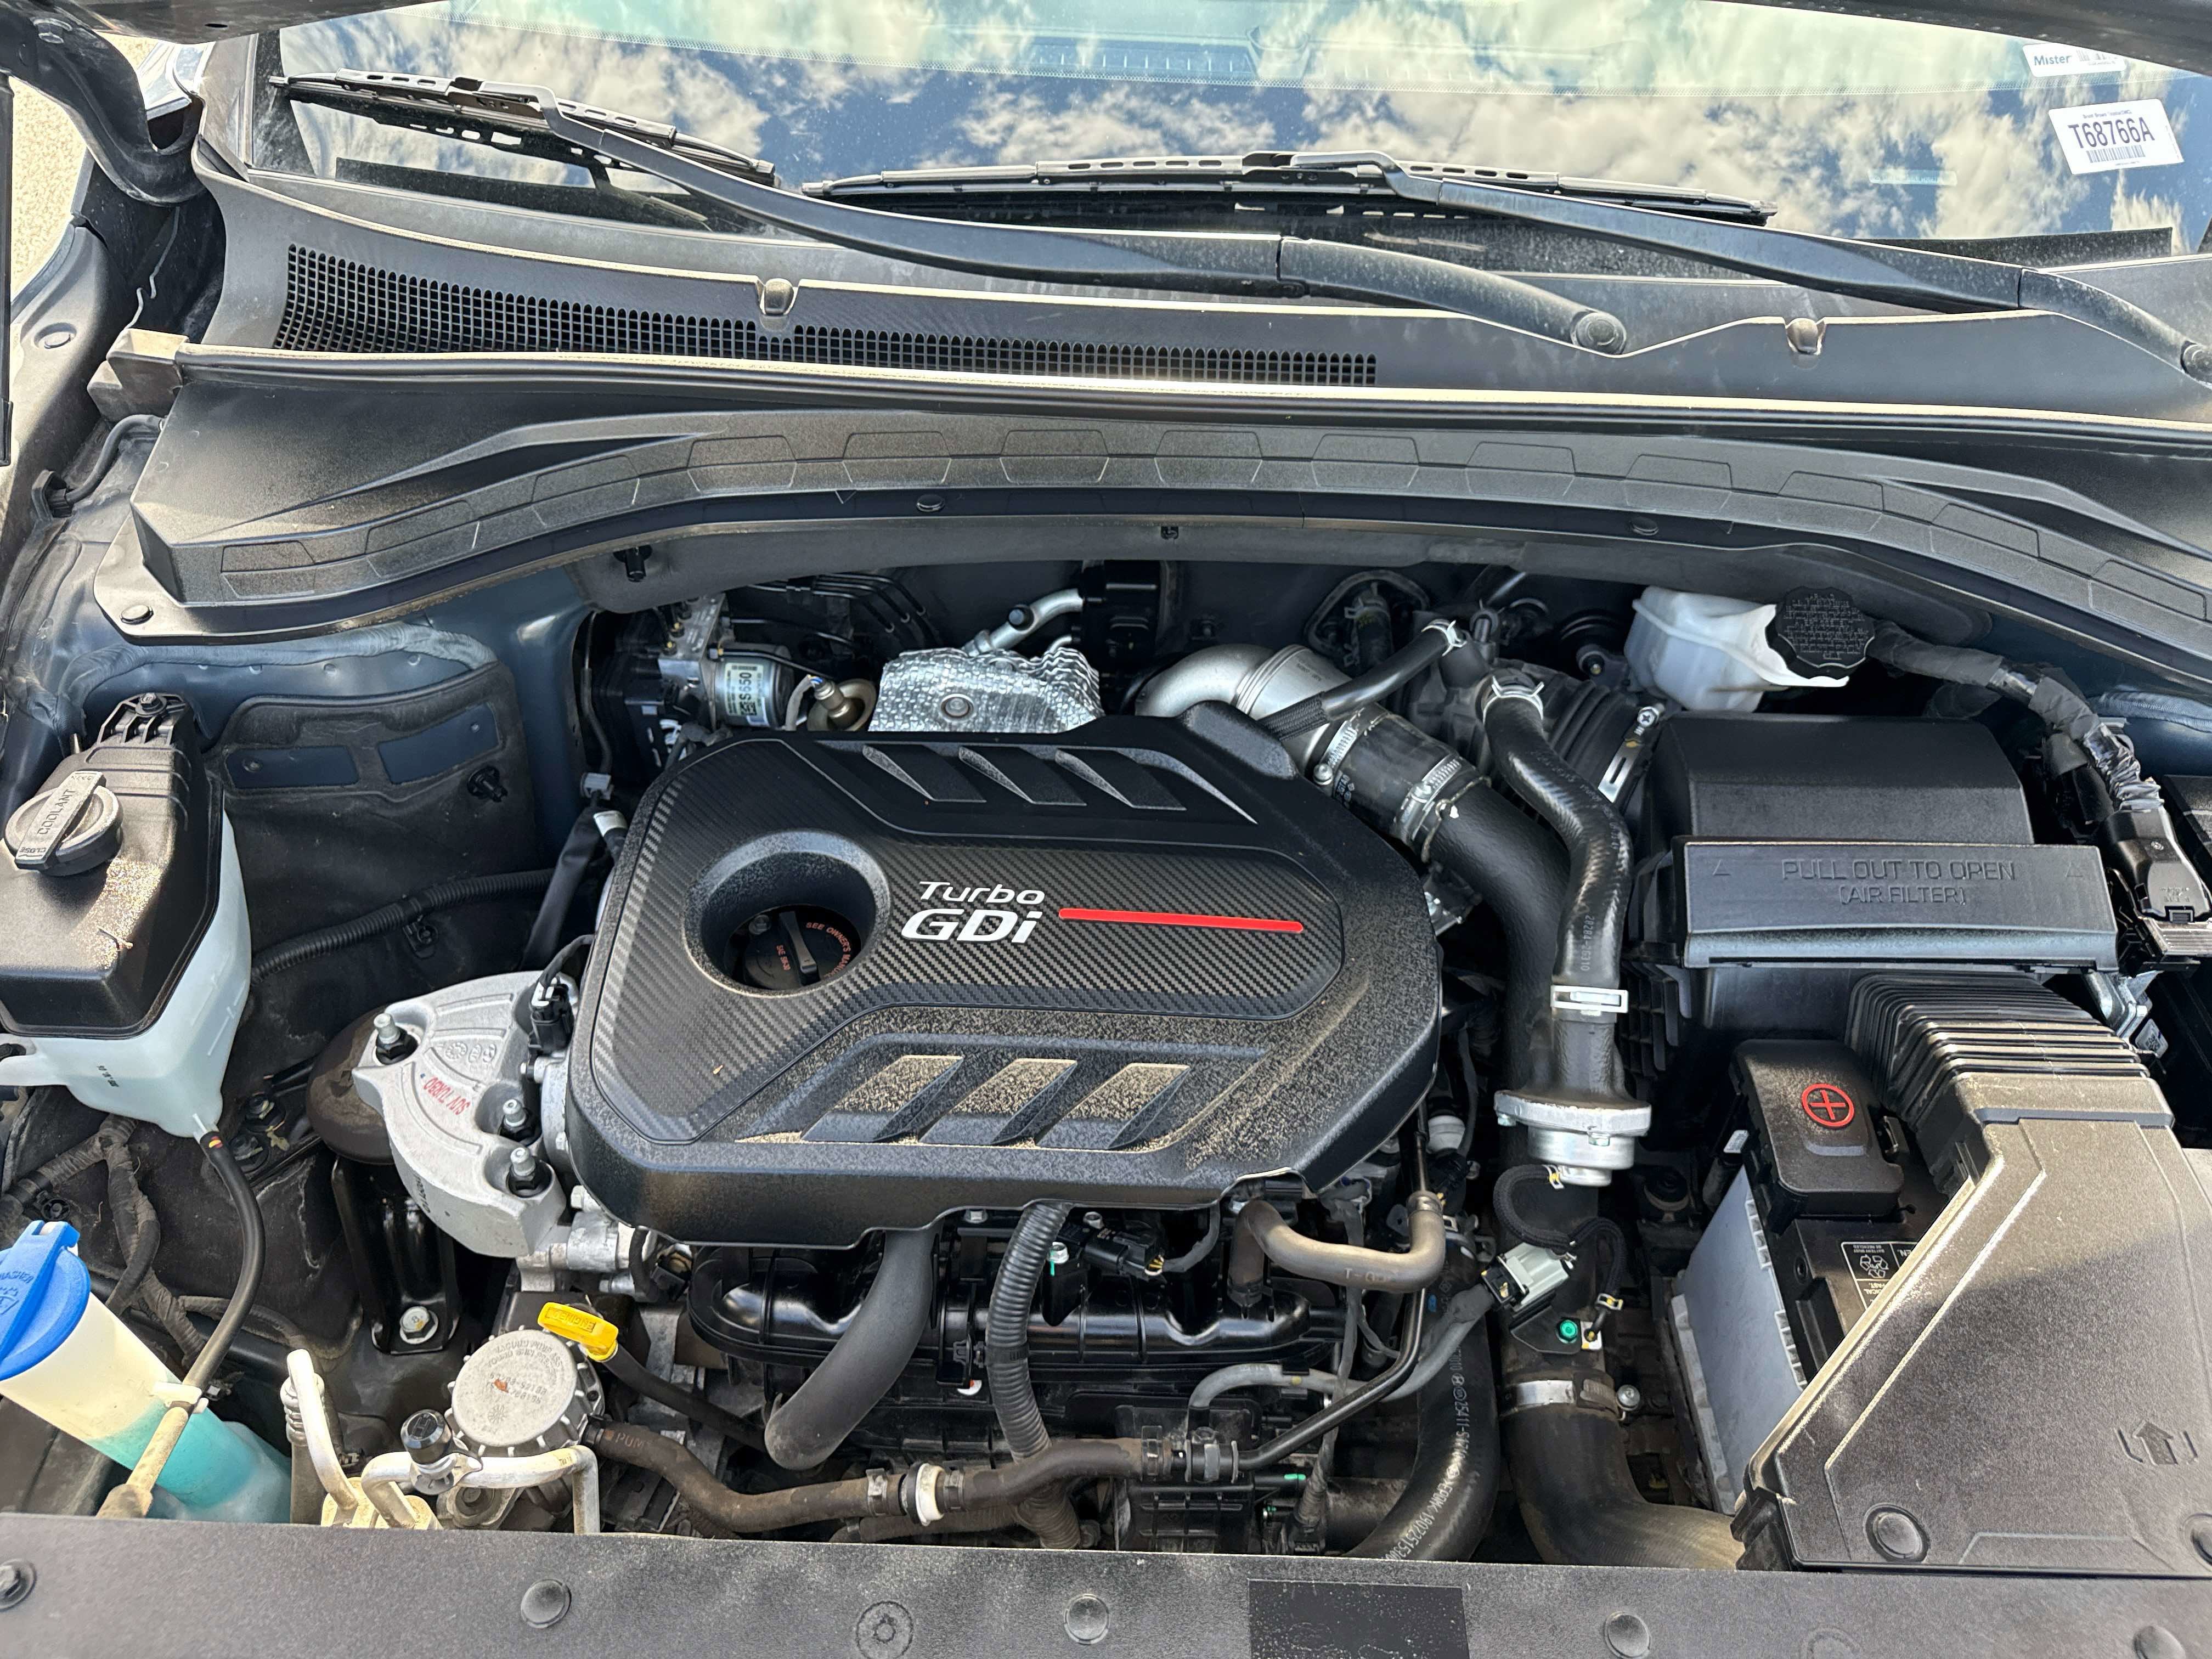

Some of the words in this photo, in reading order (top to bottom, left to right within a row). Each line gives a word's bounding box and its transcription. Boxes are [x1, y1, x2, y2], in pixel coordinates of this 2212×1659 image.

[2068, 117, 2155, 149] T68766A
[37, 789, 76, 835] COOLANT
[1782, 859, 1847, 880] PULL
[1852, 860, 1903, 880] OUT
[1909, 860, 1942, 880] TO
[1949, 860, 2016, 881] OPEN
[918, 881, 1045, 906] Turbo
[901, 908, 1043, 944] GDi
